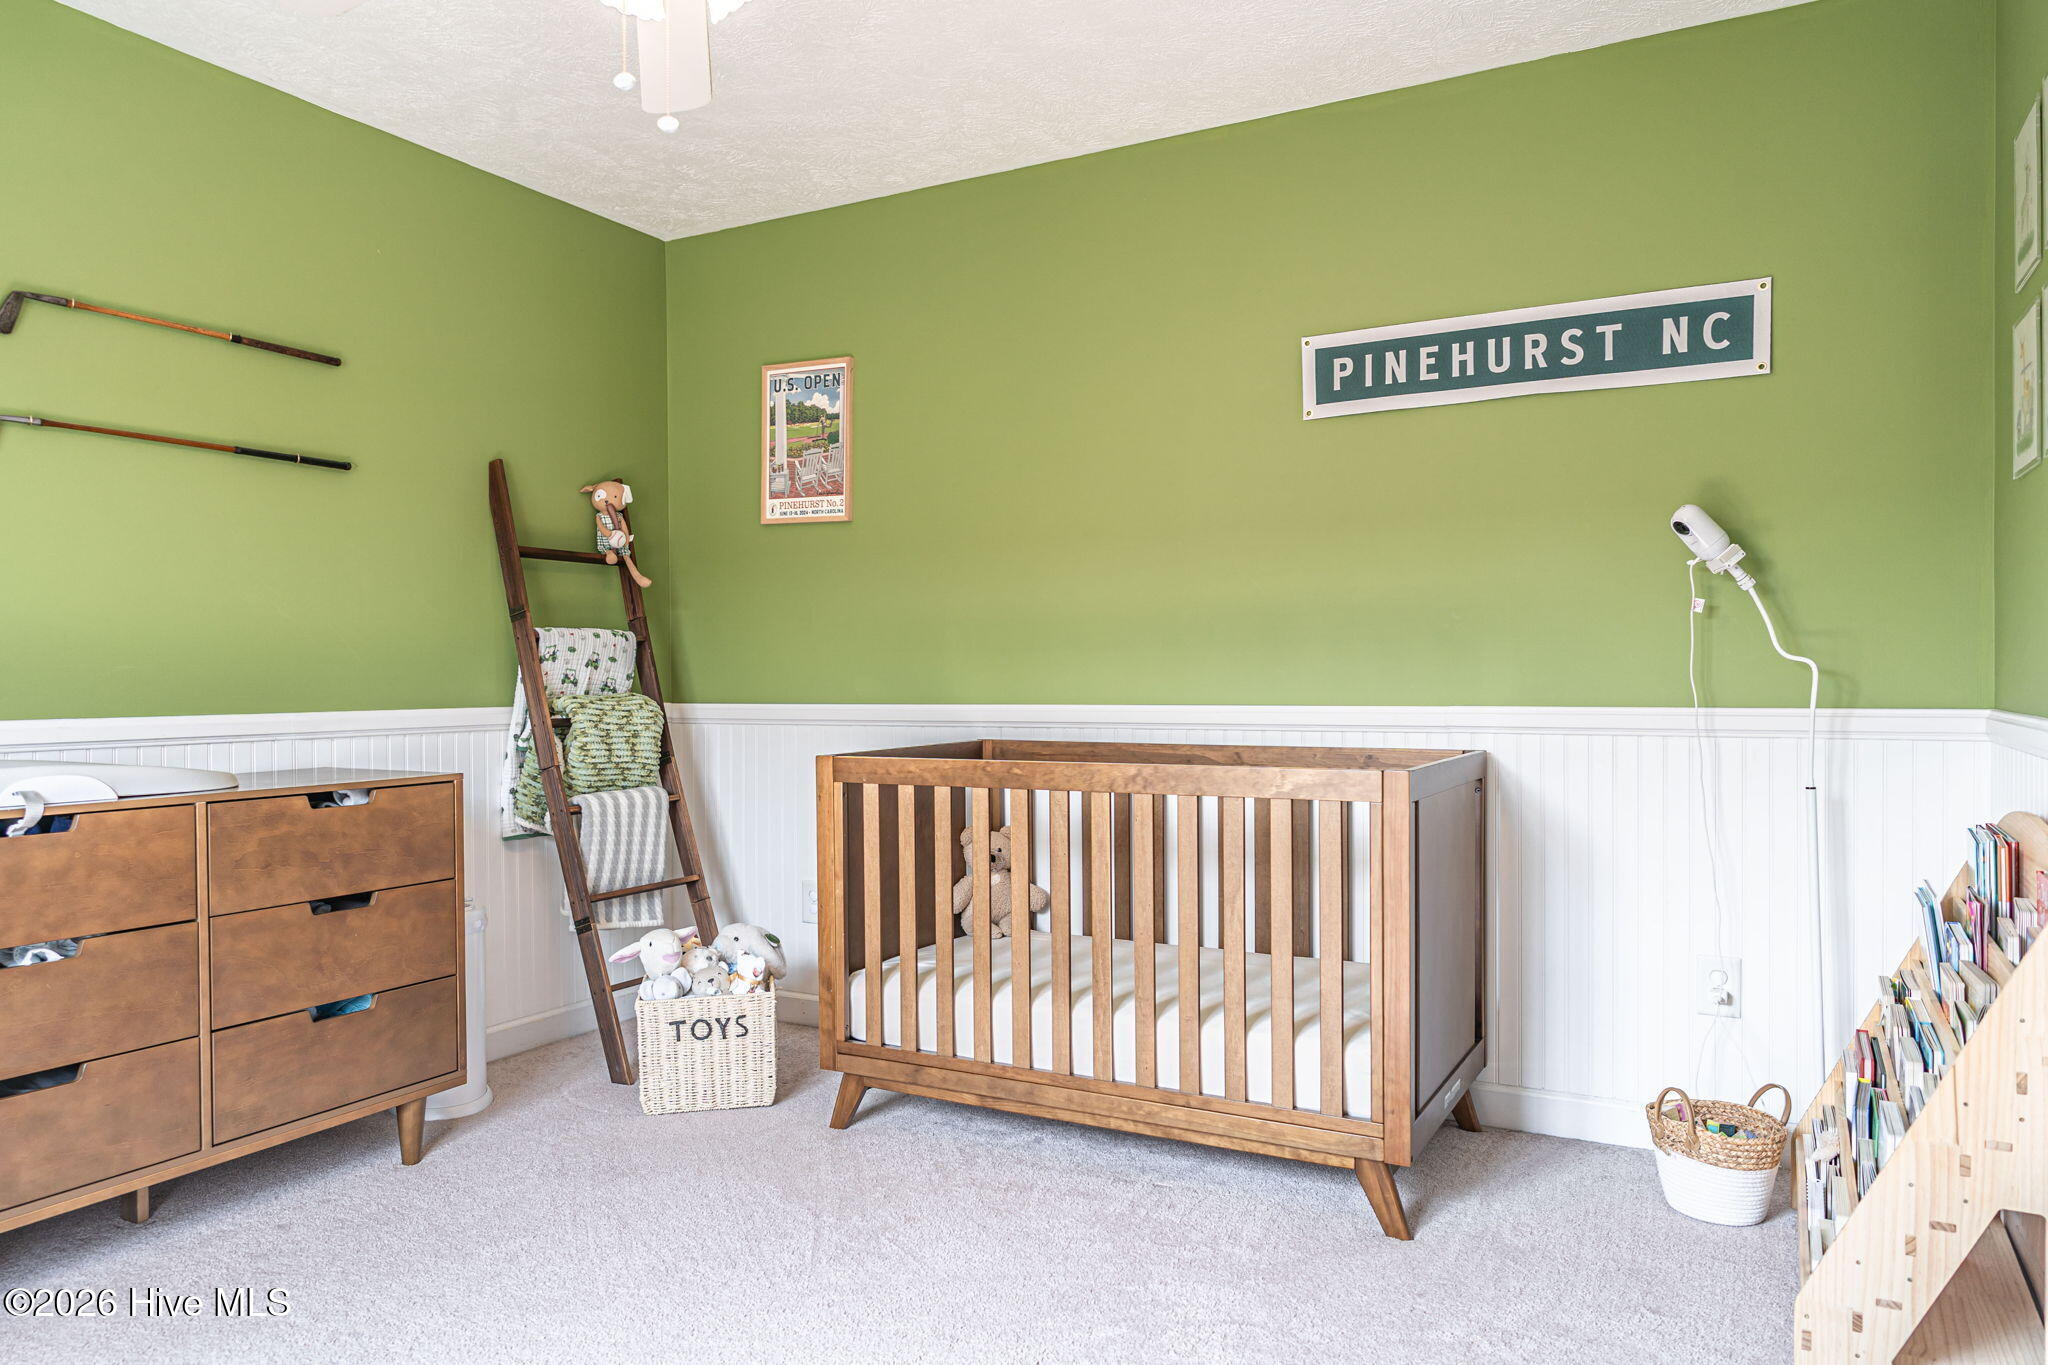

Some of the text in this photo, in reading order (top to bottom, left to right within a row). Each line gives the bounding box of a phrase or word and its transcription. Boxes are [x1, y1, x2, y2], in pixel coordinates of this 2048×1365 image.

[1333, 311, 1733, 391] PINEHURST NC
[774, 372, 841, 393] U.S. OPEN
[779, 498, 844, 510] PINEHURST No. 2
[669, 1014, 749, 1042] TOYS
